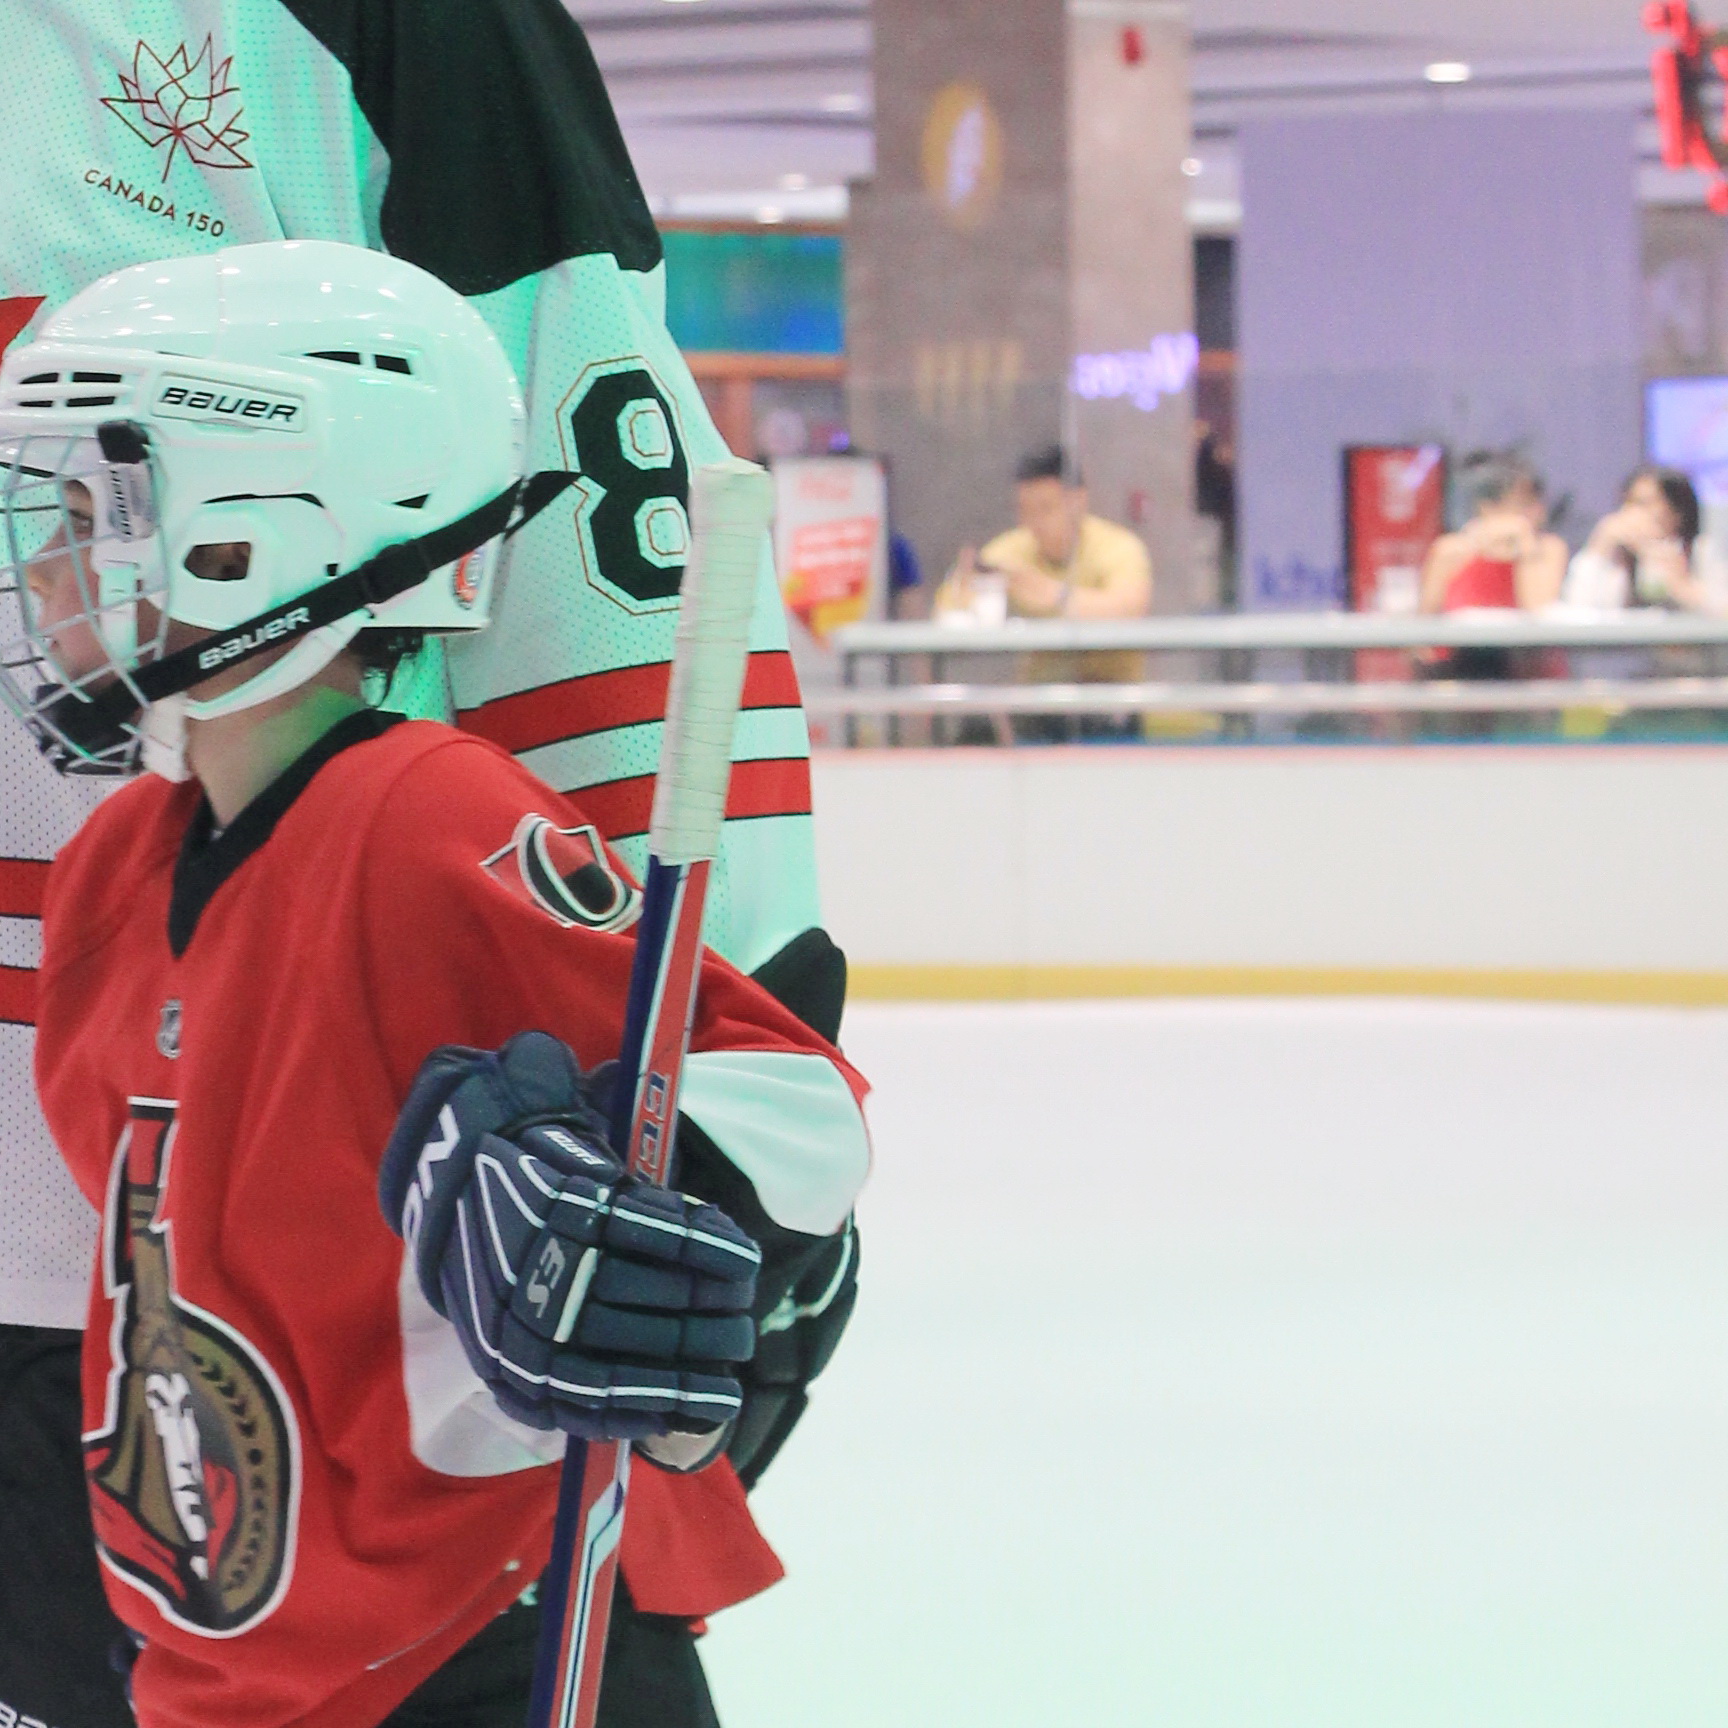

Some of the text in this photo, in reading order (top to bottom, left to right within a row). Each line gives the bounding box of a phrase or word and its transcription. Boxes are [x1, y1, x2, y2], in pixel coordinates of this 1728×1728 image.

[83, 168, 225, 238] CANADA 150
[158, 386, 299, 423] BAUER
[556, 355, 693, 615] 8
[198, 606, 312, 670] BAUER
